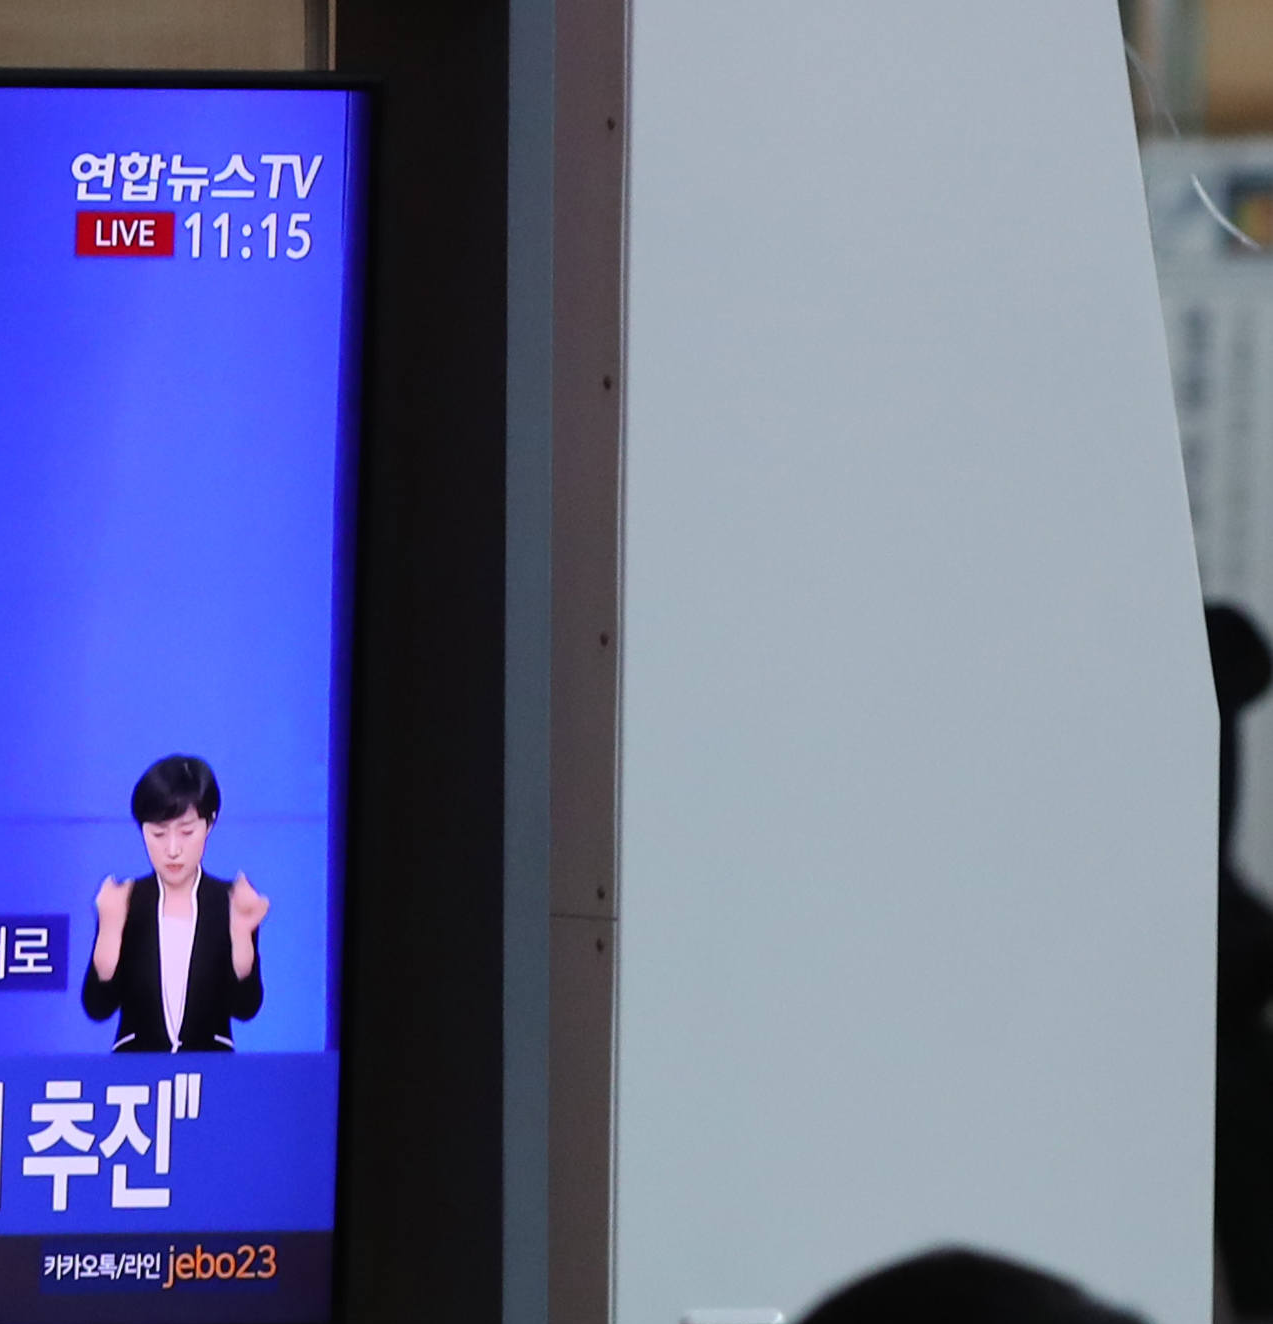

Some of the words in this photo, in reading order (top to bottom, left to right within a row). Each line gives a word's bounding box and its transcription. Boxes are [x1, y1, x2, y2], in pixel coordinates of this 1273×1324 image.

[71, 151, 324, 202] 연합뉴스TV
[95, 219, 156, 247] LIVE
[184, 212, 312, 259] 11:15
[21, 1072, 202, 1211] 추진"
[43, 1252, 162, 1281] 카카오톡/라인
[162, 1244, 277, 1290] jebo23
